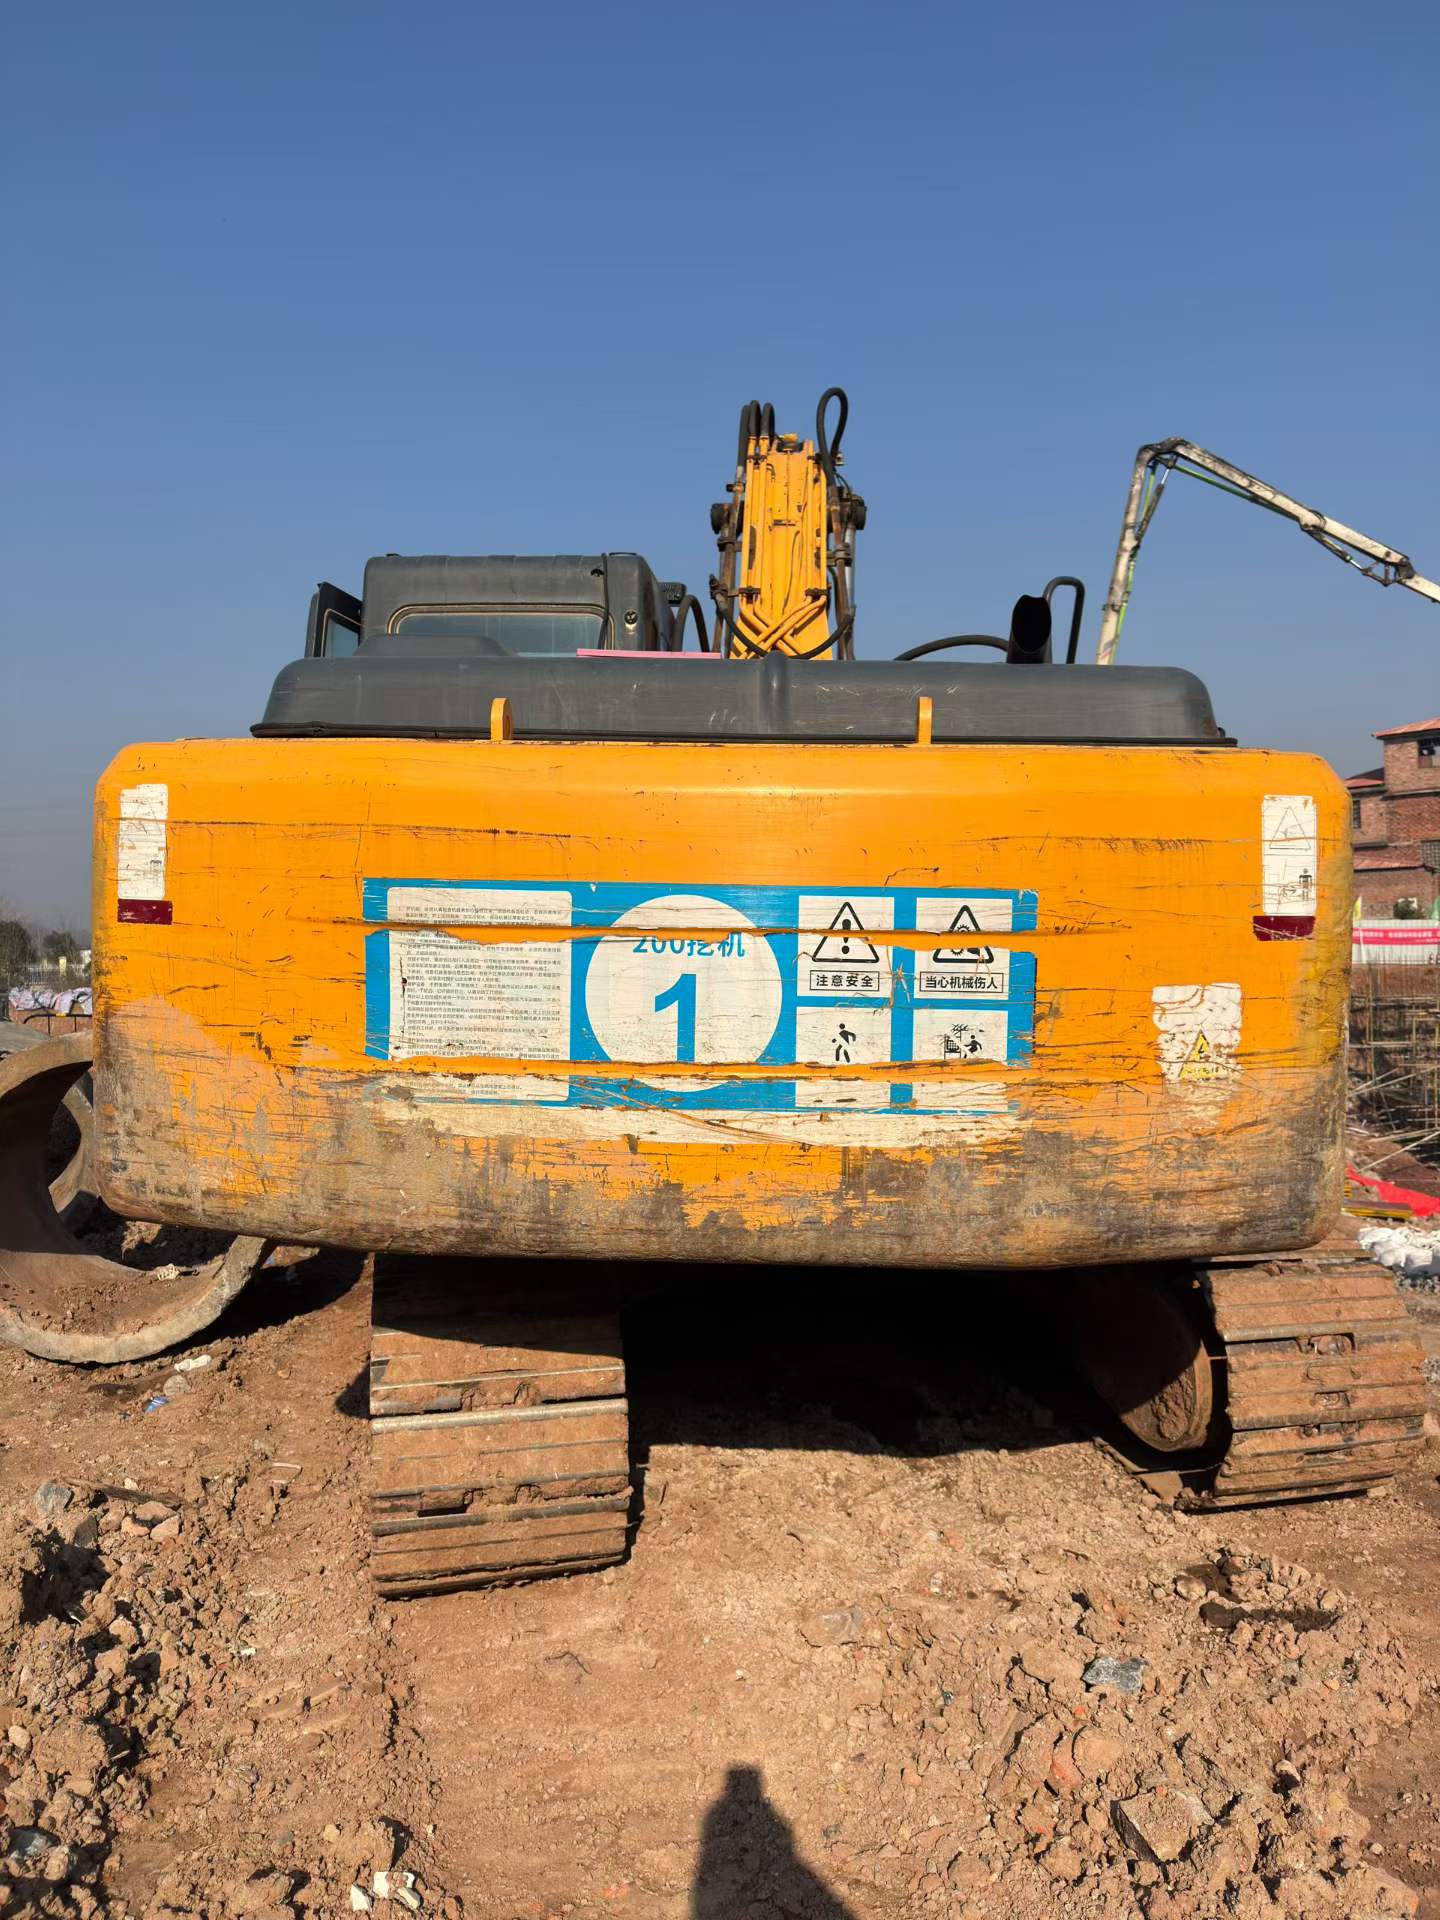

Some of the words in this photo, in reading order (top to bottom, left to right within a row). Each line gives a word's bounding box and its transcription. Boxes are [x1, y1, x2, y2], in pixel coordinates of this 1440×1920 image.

[816, 973, 874, 988] 注意安全
[925, 975, 998, 989] 当心机械伤人
[654, 973, 697, 1062] 1
